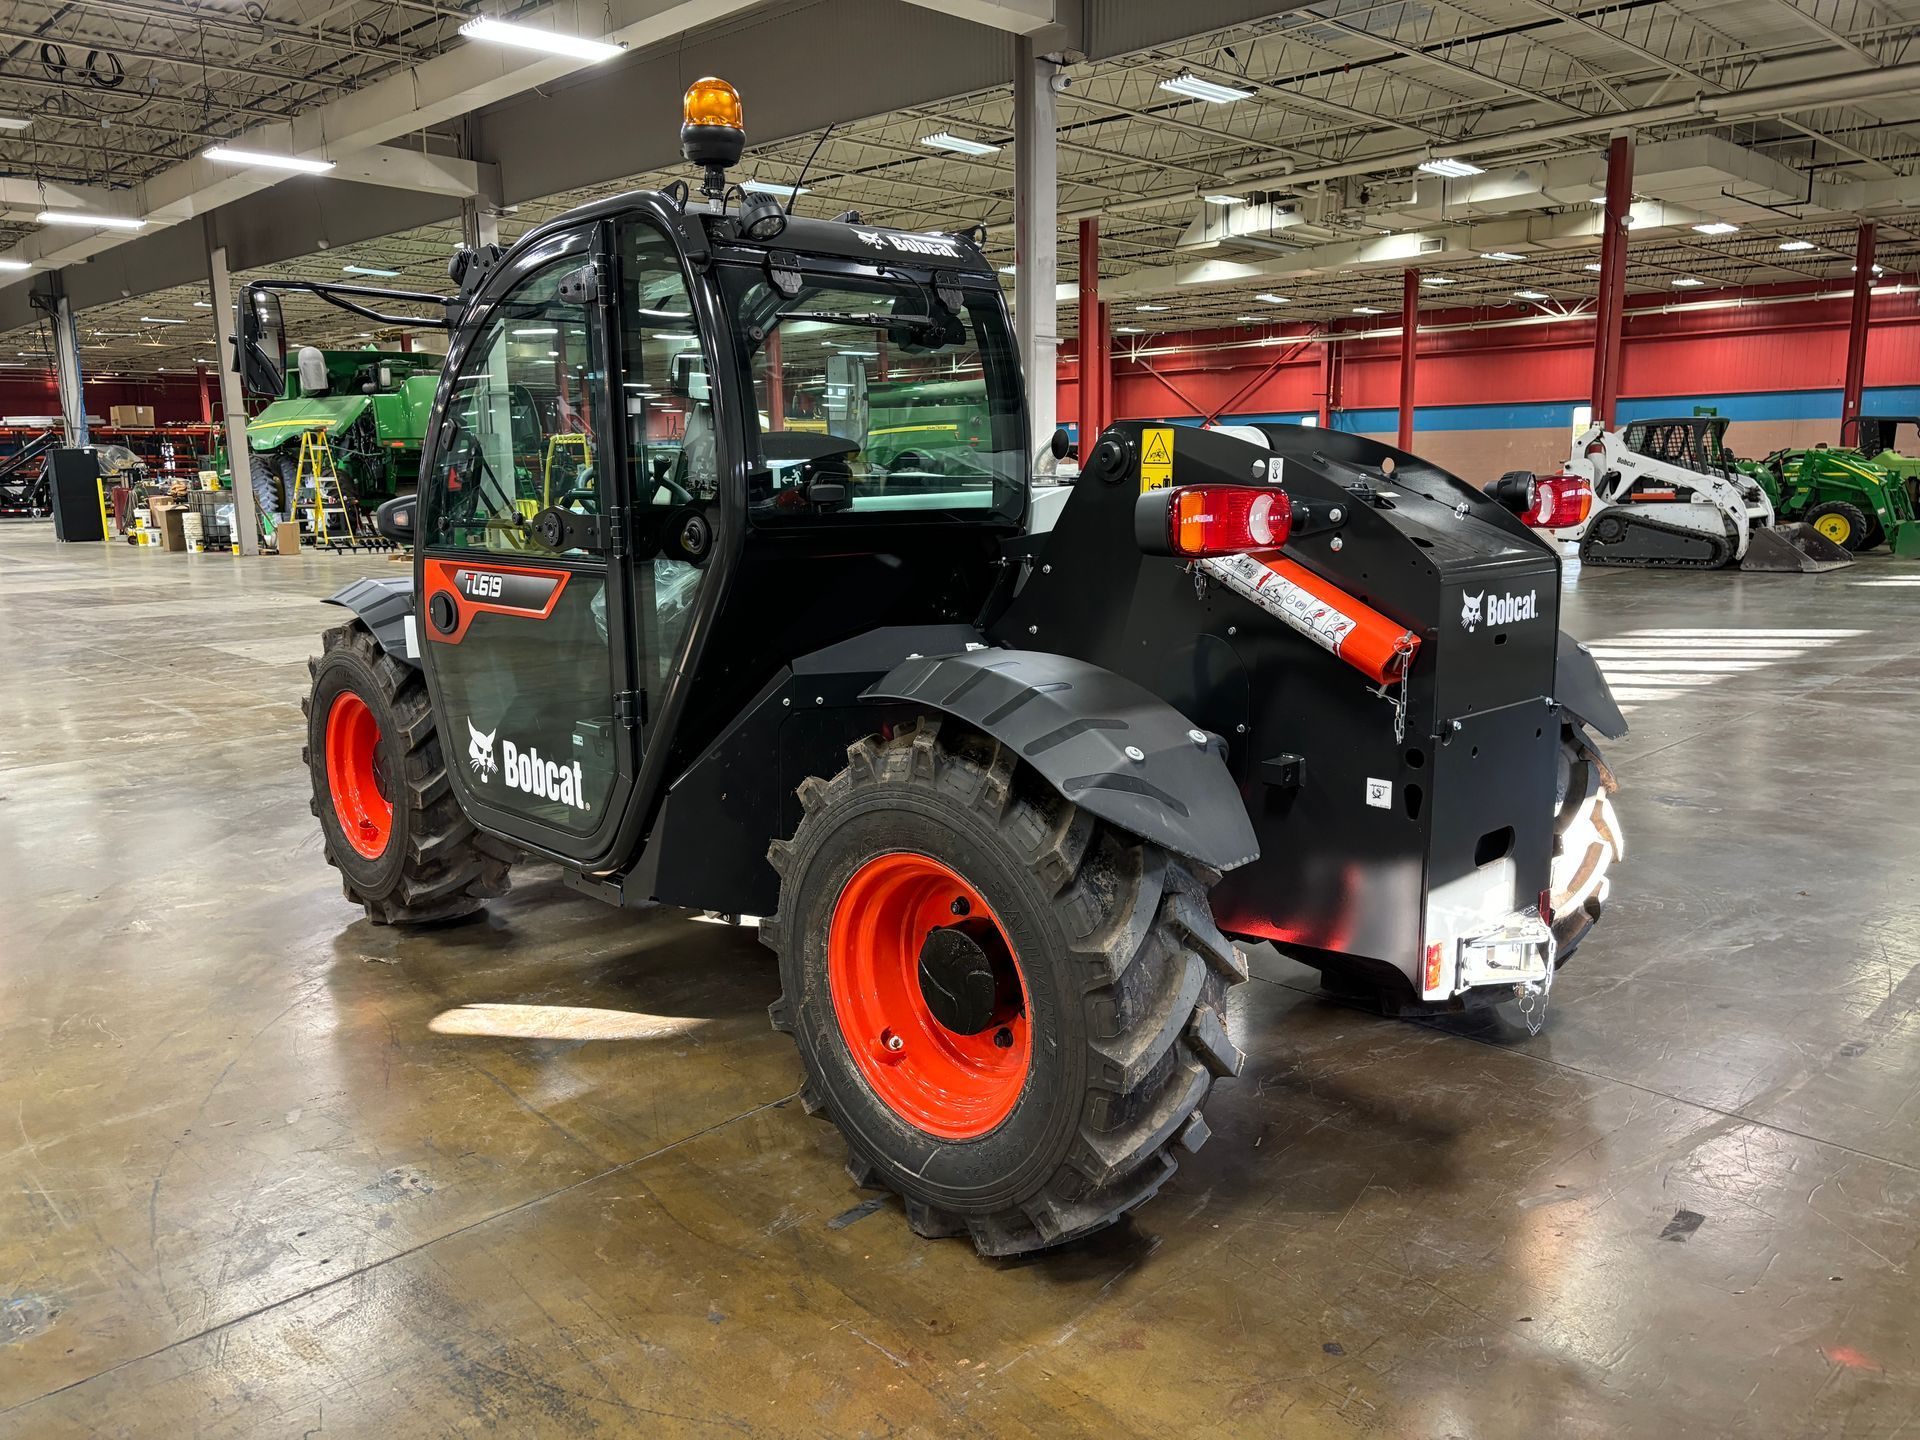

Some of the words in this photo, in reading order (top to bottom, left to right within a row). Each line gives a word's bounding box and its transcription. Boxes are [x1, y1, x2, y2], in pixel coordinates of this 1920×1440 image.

[886, 235, 960, 258] Bobcat
[1616, 456, 1637, 468] Bobcat
[465, 573, 503, 598] TL619
[1486, 589, 1536, 627] Bobcat
[502, 740, 585, 810] Bobcat
